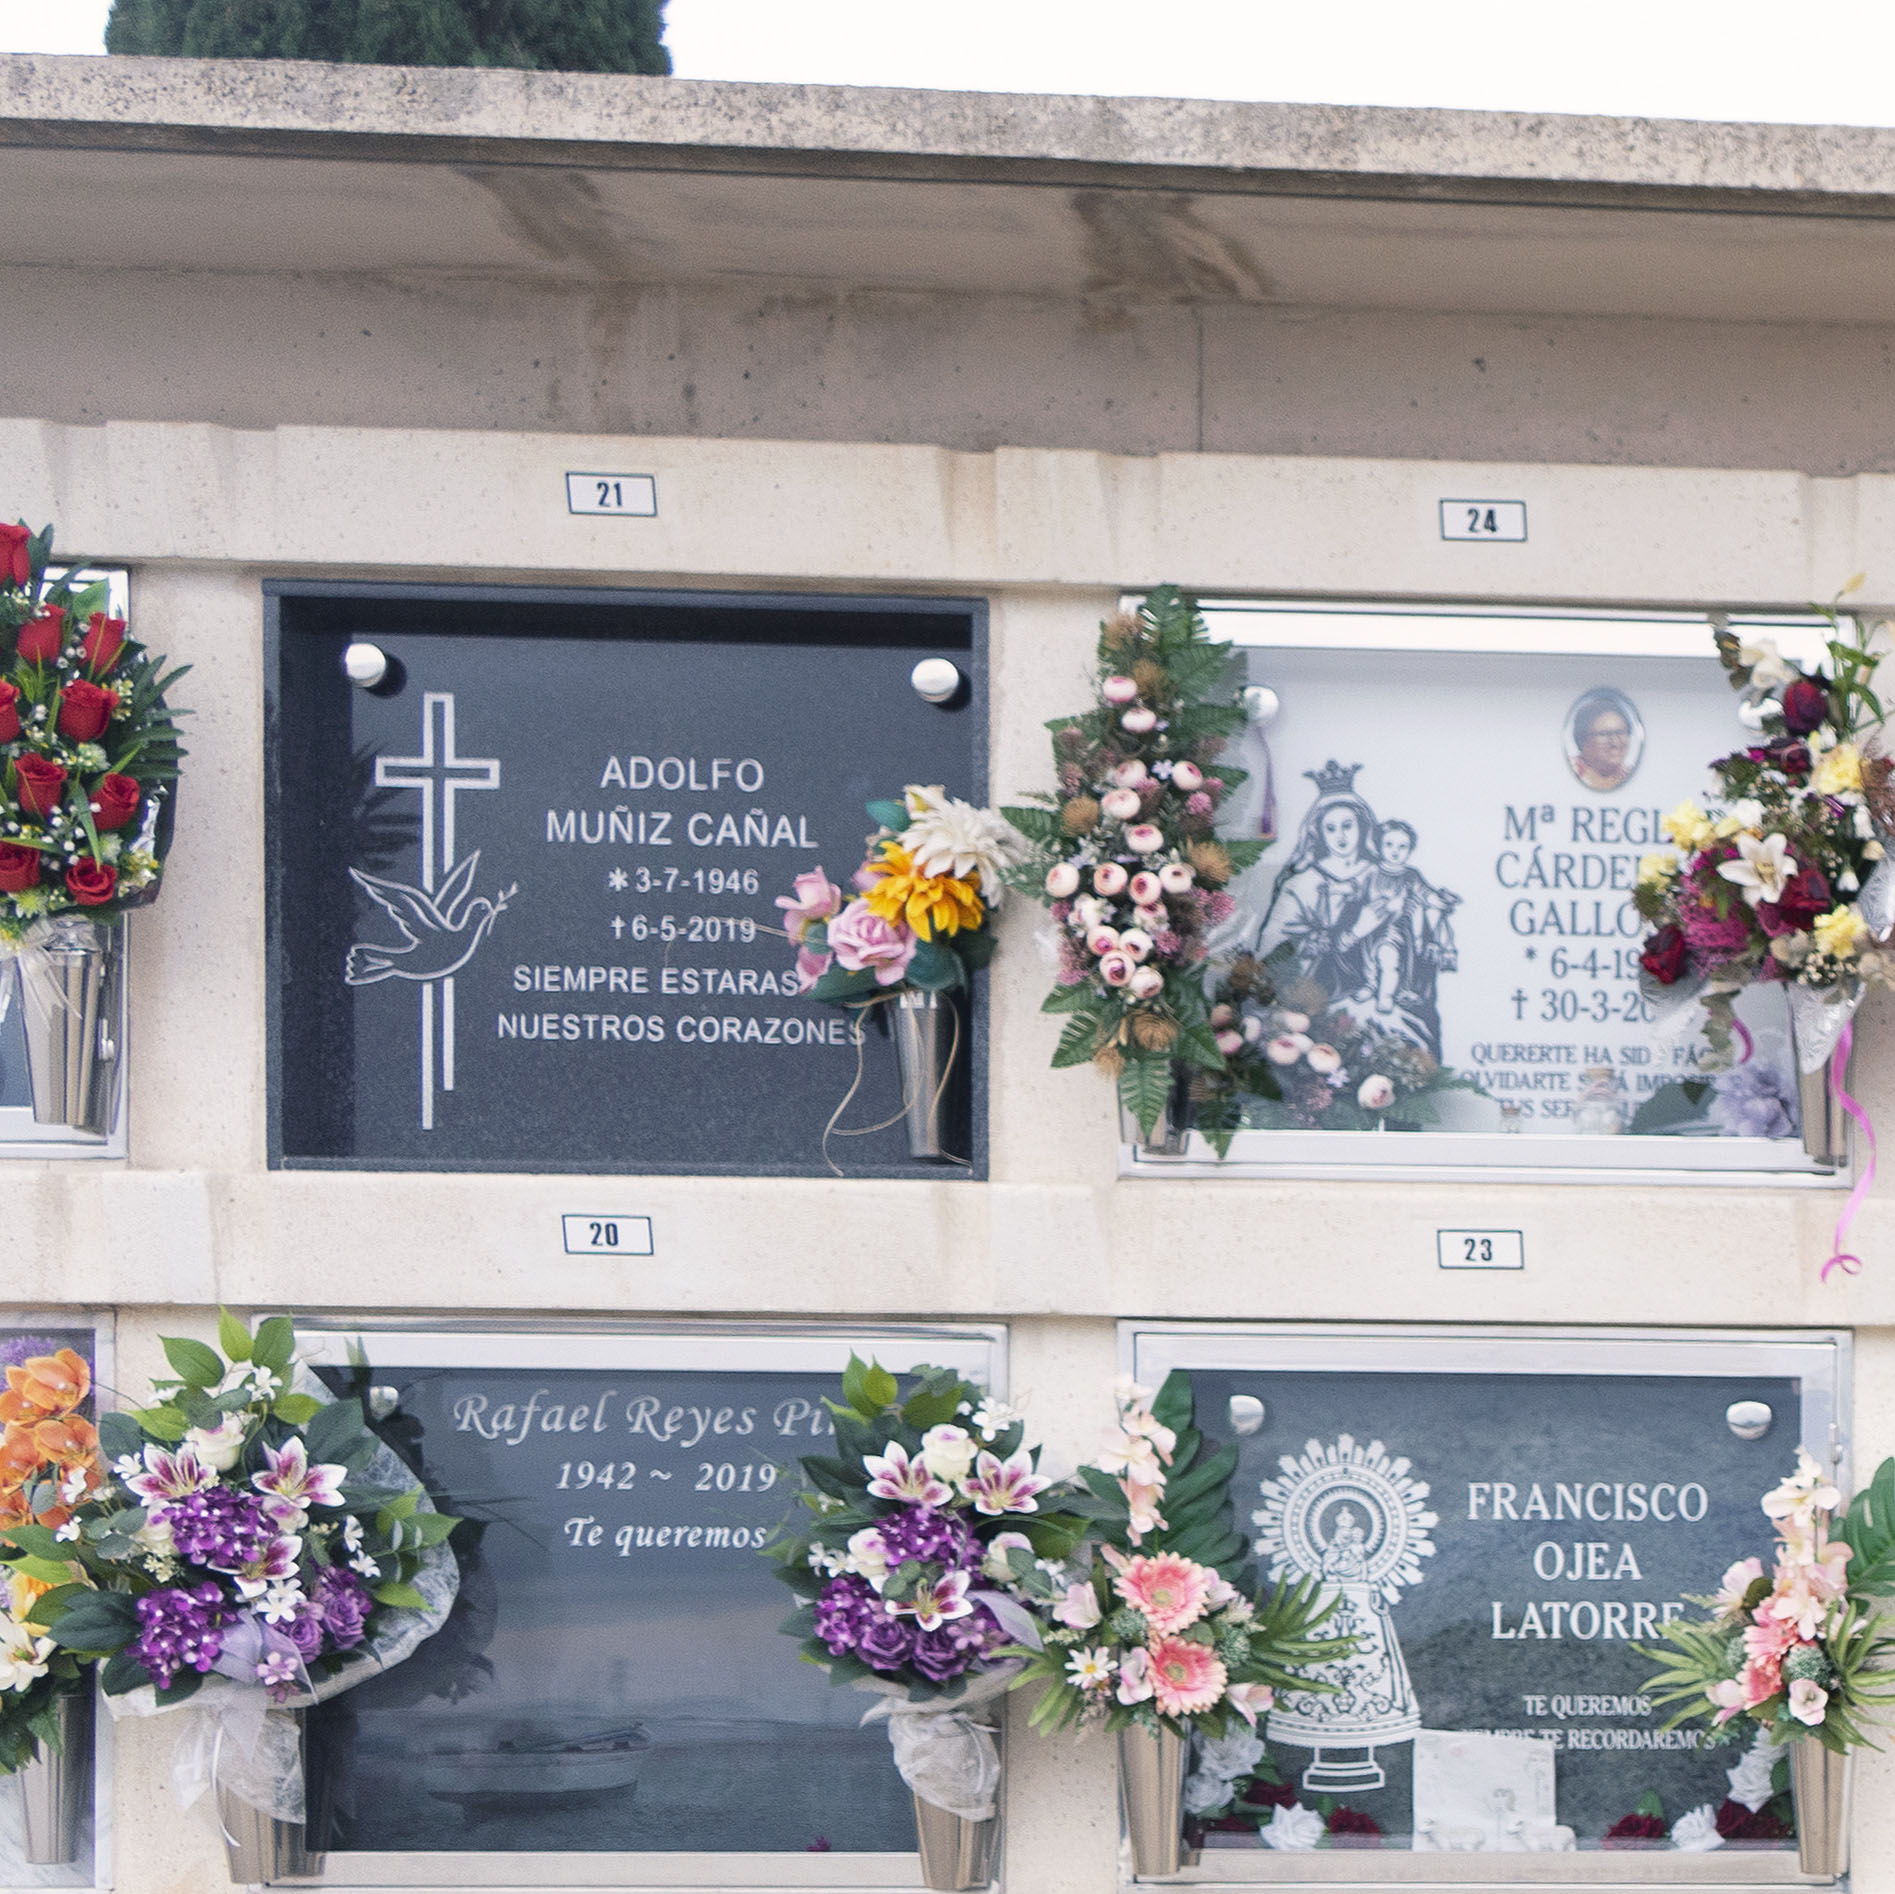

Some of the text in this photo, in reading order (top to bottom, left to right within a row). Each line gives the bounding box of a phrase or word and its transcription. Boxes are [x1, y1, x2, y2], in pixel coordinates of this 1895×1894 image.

[596, 482, 624, 508] 21
[1467, 508, 1497, 534] 24
[600, 756, 765, 793] ADOLFO
[546, 806, 819, 849] MUÑIZ CAÑAL
[1571, 806, 1671, 845] REGL
[635, 867, 759, 895] 3-7-1946
[1495, 846, 1640, 890] CÁRDE
[513, 964, 649, 993] SIEMPRE
[498, 1012, 866, 1045] NUESTROS CORAZONES
[1471, 1043, 1577, 1066] QUERERTE
[1583, 1046, 1614, 1065] HA
[1619, 1047, 1652, 1066] SID
[590, 1222, 618, 1247] 20
[1464, 1237, 1492, 1261] 23
[454, 1390, 757, 1448] Rafael Reyes
[556, 1461, 777, 1492] 1942 2019
[1467, 1482, 1709, 1522] FRANCISCO
[564, 1516, 768, 1557] Te queremos
[1533, 1541, 1643, 1580] OJEA
[1522, 1695, 1652, 1719] TE QUEREMOS
[1568, 1729, 1716, 1751] RECORDAREMOS
